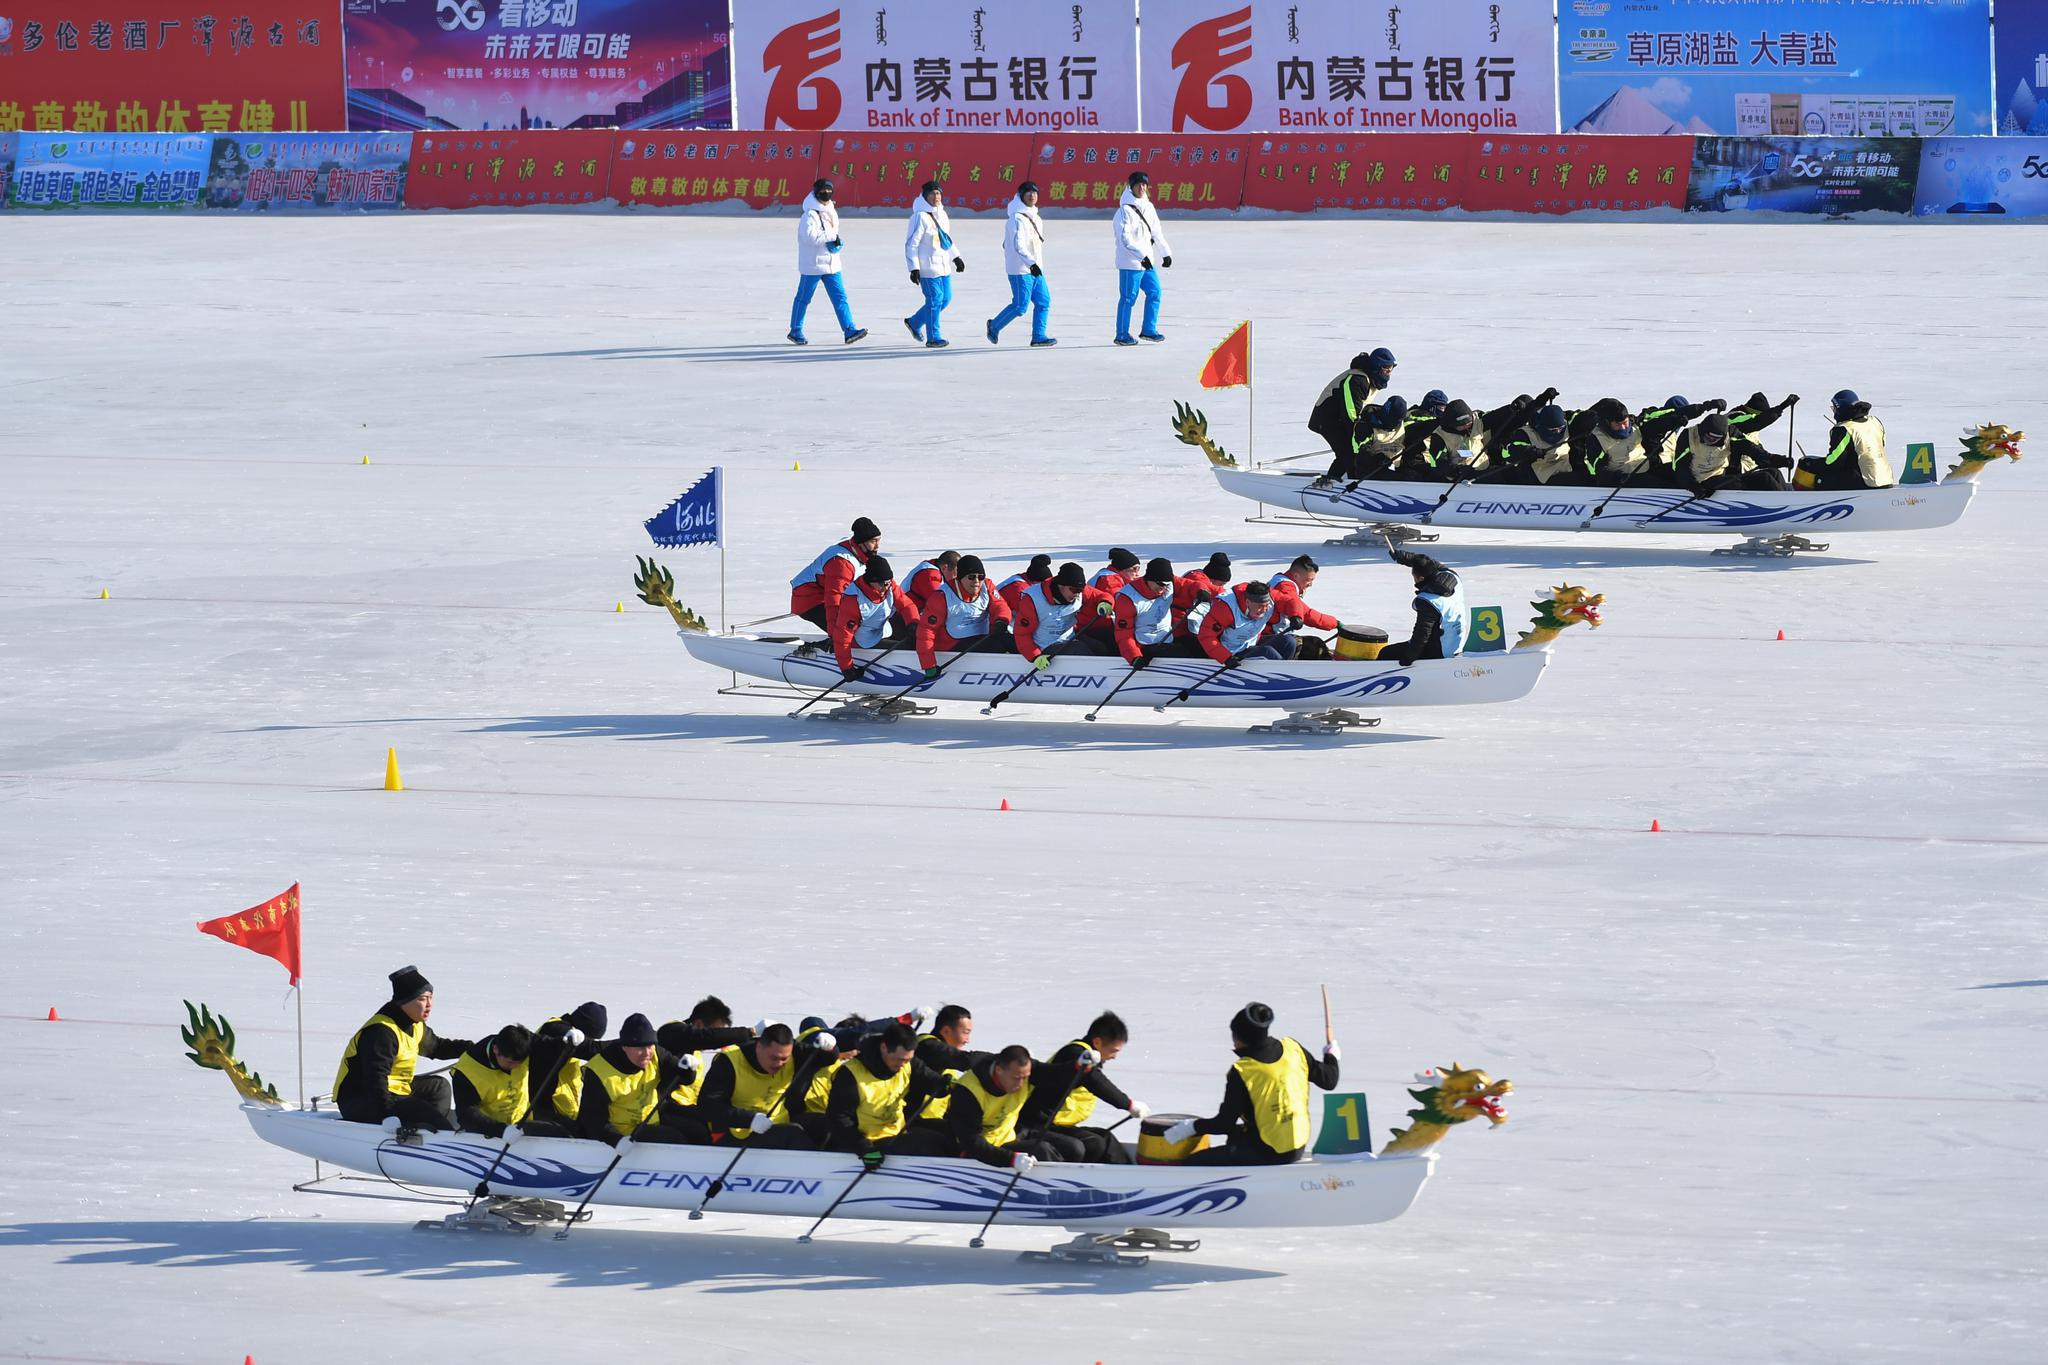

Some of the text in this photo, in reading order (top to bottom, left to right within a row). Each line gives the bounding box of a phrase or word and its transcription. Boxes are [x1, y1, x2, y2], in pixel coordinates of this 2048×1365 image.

[499, 0, 578, 28] 看移动
[23, 20, 181, 51] 多伦老酒厂
[484, 34, 631, 60] 未来无限可能
[1627, 31, 1838, 67] 草原湖盐 大青盐
[493, 67, 530, 79] 多彩业务
[541, 67, 578, 79] 专属权益
[588, 67, 627, 79] 尊享服务
[866, 56, 1098, 102] 内蒙古银行
[1277, 56, 1516, 102] 内蒙古银行
[867, 107, 1099, 131] Bank of Inner Mongolia
[1279, 107, 1518, 132] Bank of Inner Mongolia
[1856, 151, 1891, 164] 看移动
[1832, 166, 1899, 177] 未来无限可能
[16, 170, 75, 202] 绿色草原
[79, 170, 138, 203] 银色冬运
[141, 170, 201, 203] 金色梦想
[246, 168, 319, 202] 相约十四冬
[327, 168, 400, 203] 魅力内蒙古
[630, 176, 790, 198] 敬尊敬的体育健儿
[1050, 180, 1216, 202] 敬尊敬的育健儿
[1911, 447, 1932, 475] 4
[1456, 502, 1586, 516] CHAMPION
[1477, 610, 1500, 642] 3
[958, 672, 1107, 689] CHAMPION
[1336, 1097, 1360, 1141] 1
[619, 1171, 823, 1196] CHAMPION
